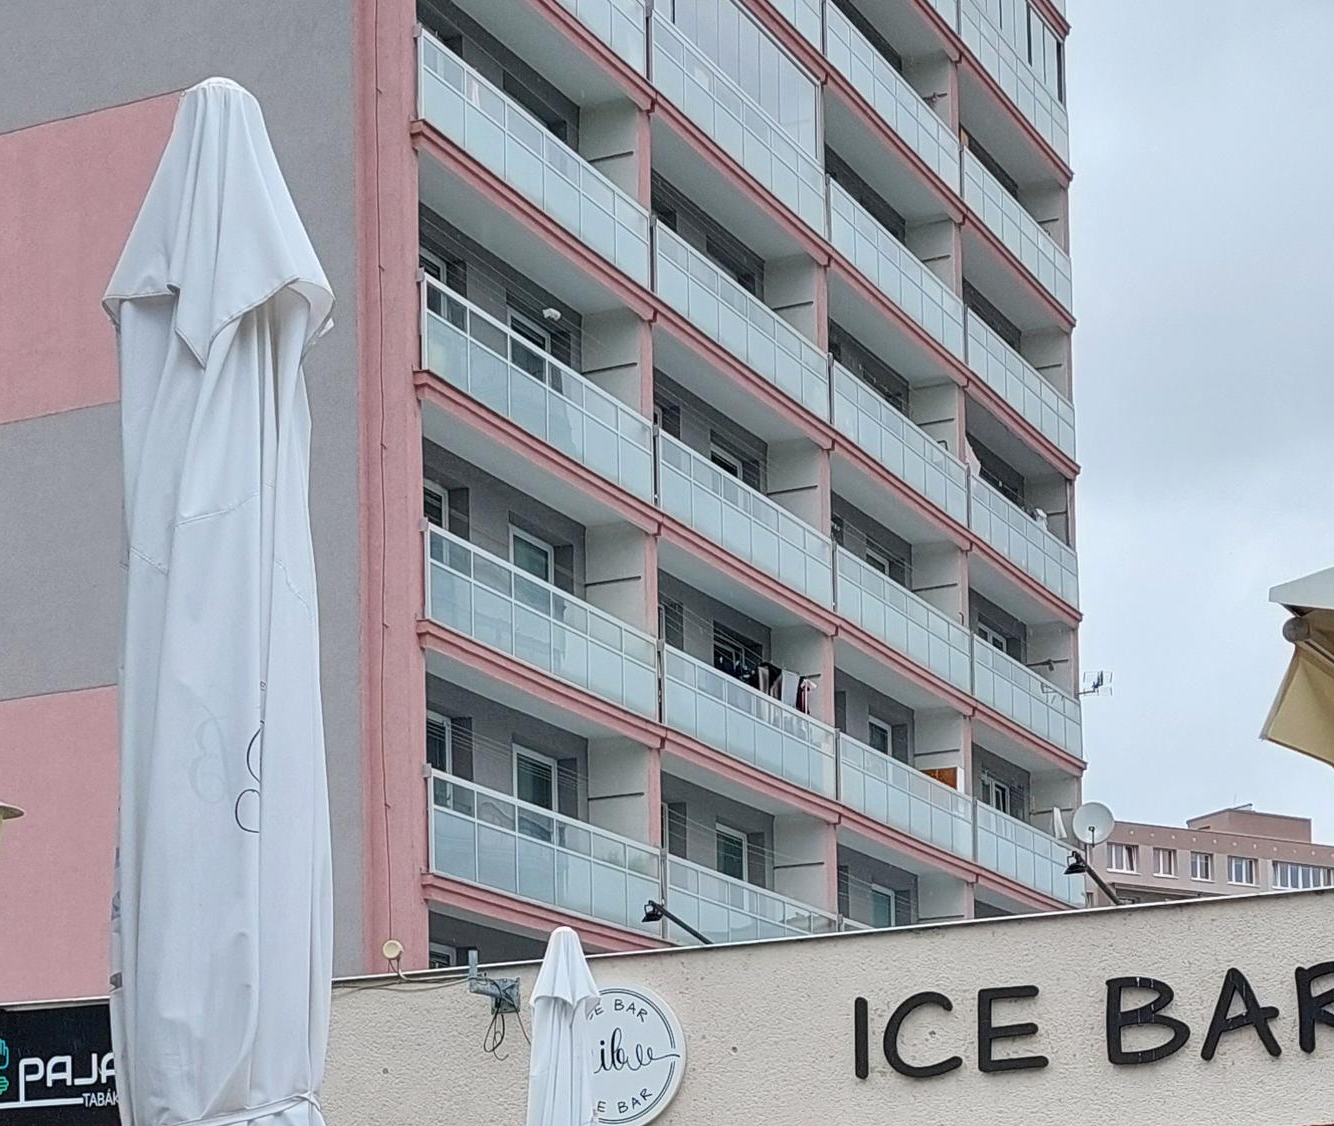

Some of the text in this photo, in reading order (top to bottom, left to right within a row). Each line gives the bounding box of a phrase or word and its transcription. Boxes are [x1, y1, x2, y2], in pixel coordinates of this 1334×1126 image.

[615, 999, 648, 1023] BAR
[853, 984, 1049, 1080] ICE
[18, 1053, 117, 1102] PAJA
[617, 1087, 653, 1115] BAR
